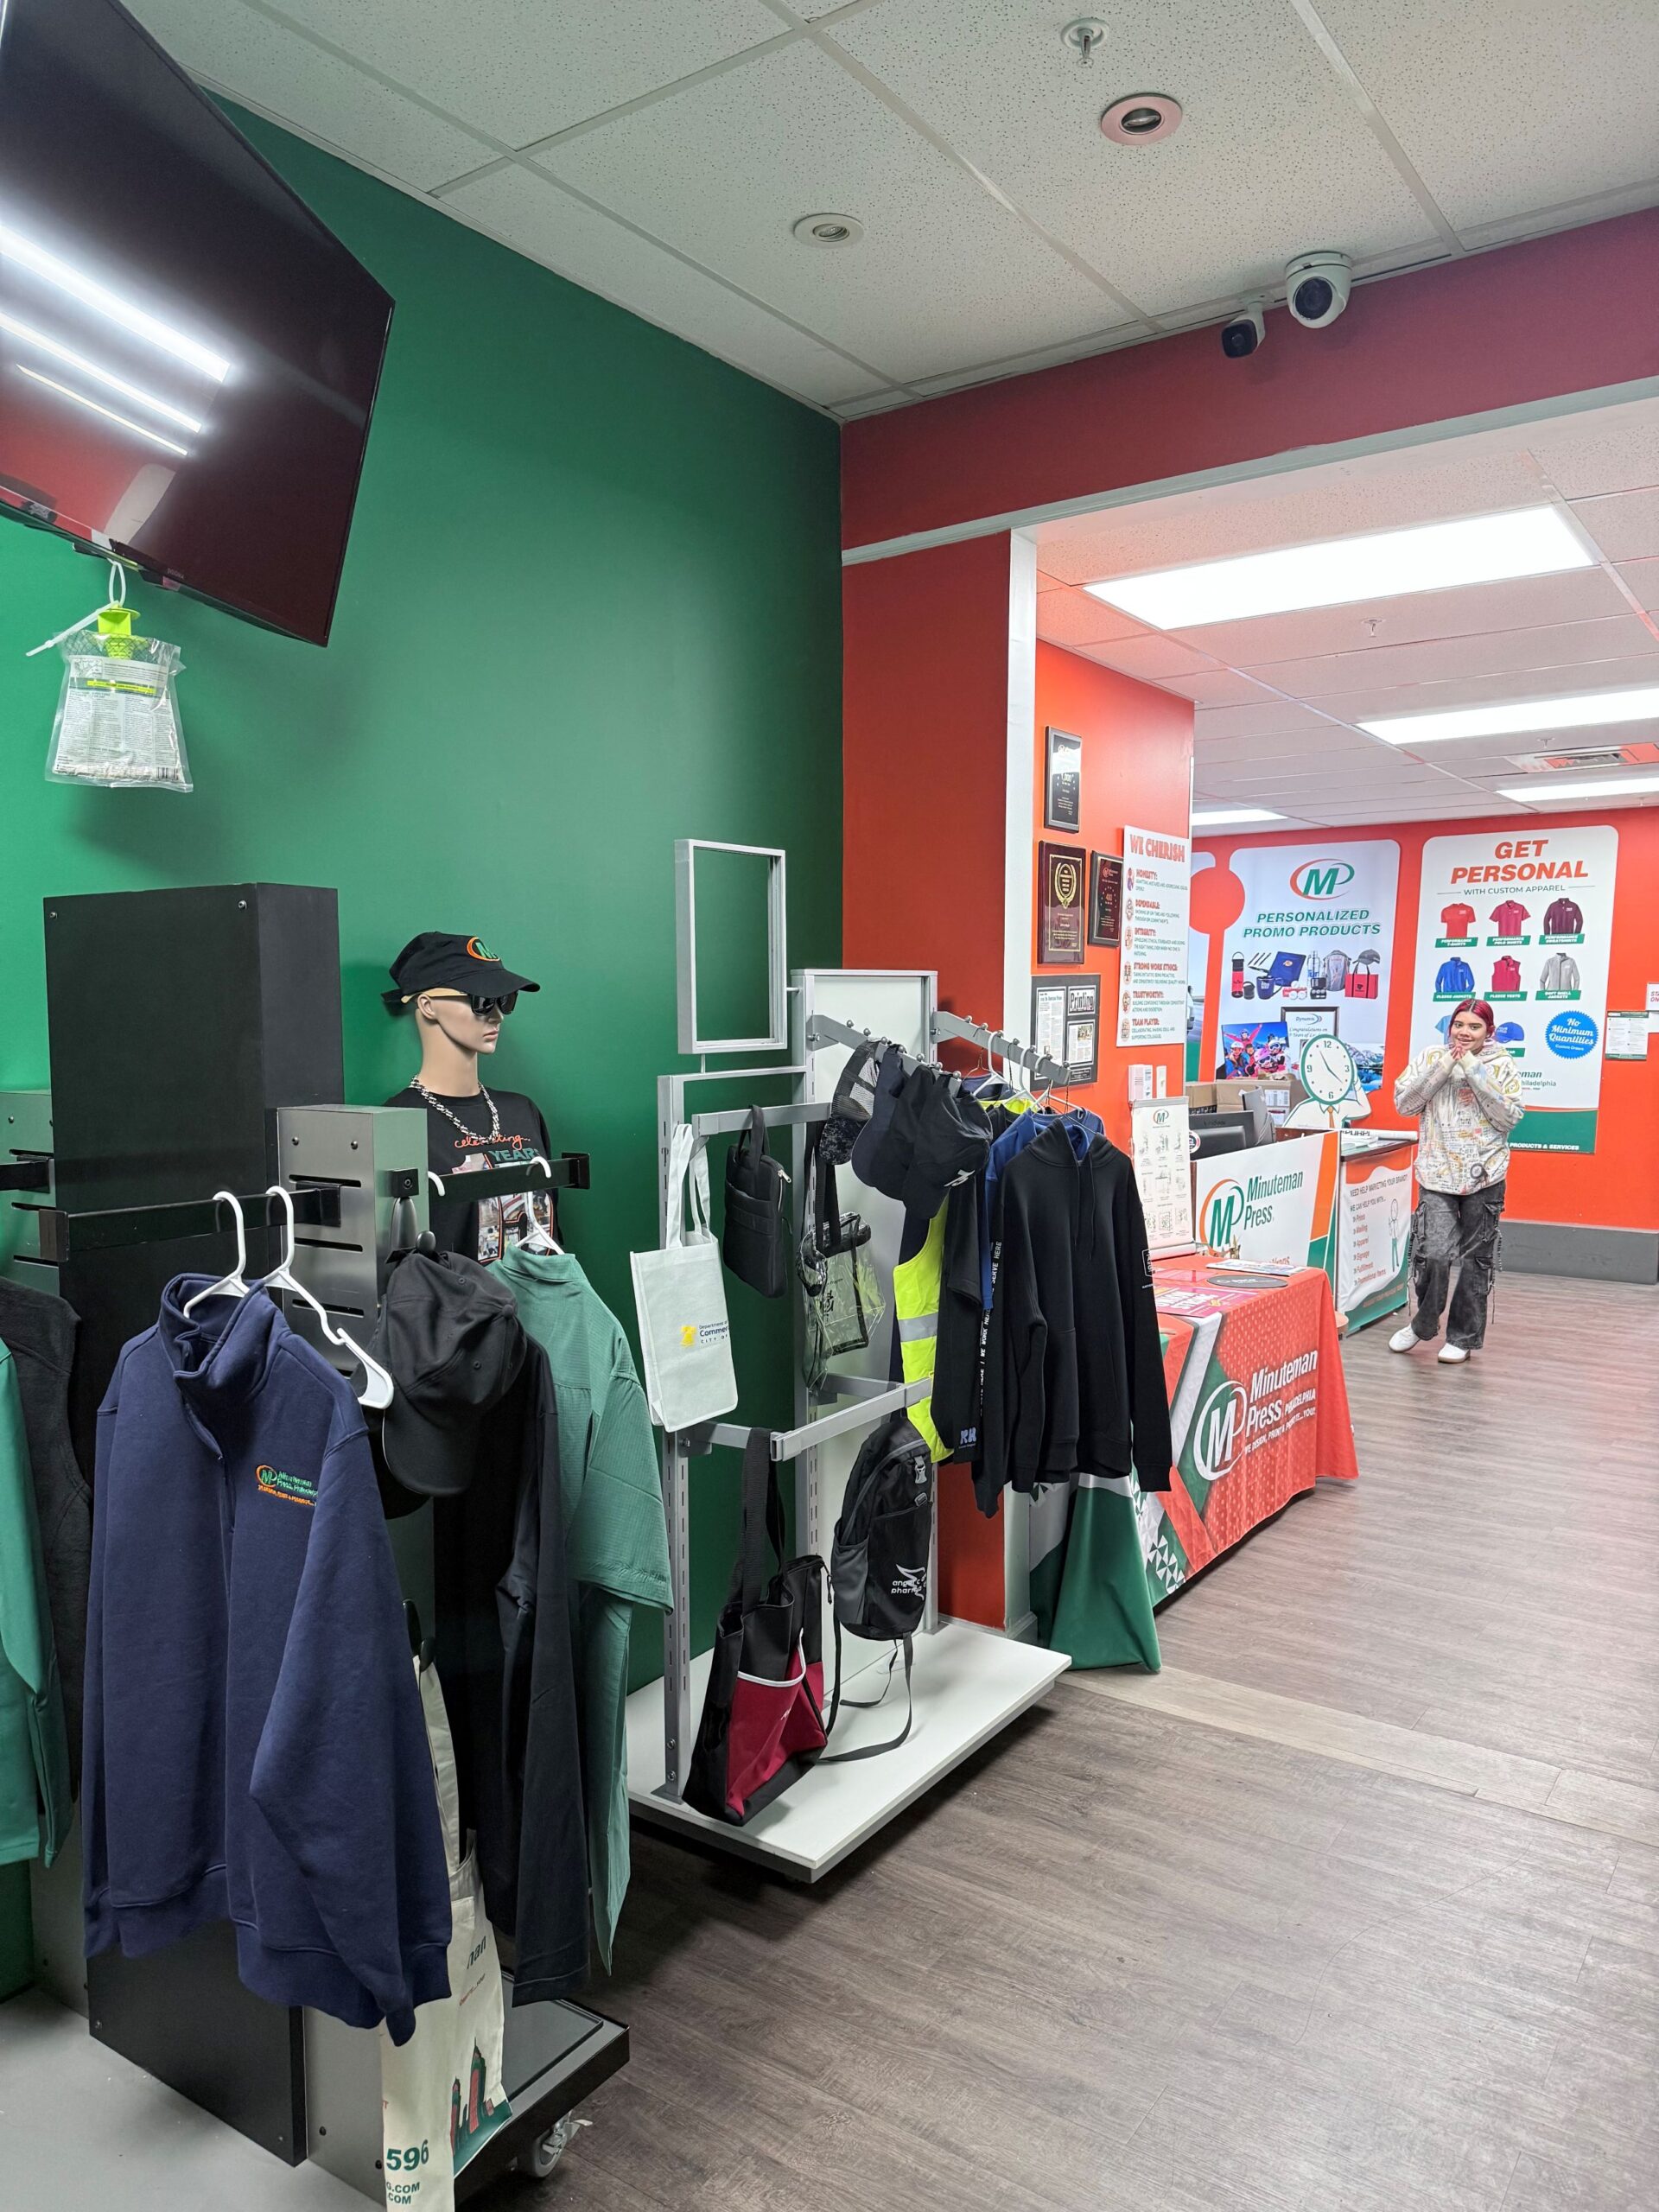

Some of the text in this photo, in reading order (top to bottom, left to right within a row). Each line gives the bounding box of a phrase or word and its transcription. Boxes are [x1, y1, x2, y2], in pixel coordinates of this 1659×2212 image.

[1130, 835, 1185, 862] WE CHERISH
[1495, 840, 1548, 859] GET
[1451, 861, 1589, 885] PERSONAL
[1257, 910, 1370, 923] PERSONALIZED
[1243, 924, 1381, 938] PROMO PRODUCTS
[1070, 992, 1094, 1011] Printing
[1132, 1018, 1144, 1027] TEAM
[1551, 1027, 1594, 1037] Minimum
[1567, 1018, 1582, 1027] No
[1324, 1040, 1332, 1049] 12
[1548, 1033, 1594, 1046] Quantities
[1306, 1065, 1313, 1073] 9
[1246, 1171, 1304, 1203] Minuteman
[1351, 1189, 1359, 1198] NEED
[1369, 1180, 1387, 1192] MARKETING
[1243, 1205, 1273, 1230] Press
[993, 1241, 1002, 1260] HERE
[1249, 1350, 1319, 1403] Minuteman
[1245, 1400, 1282, 1438] Press
[386, 2139, 429, 2171] 596
